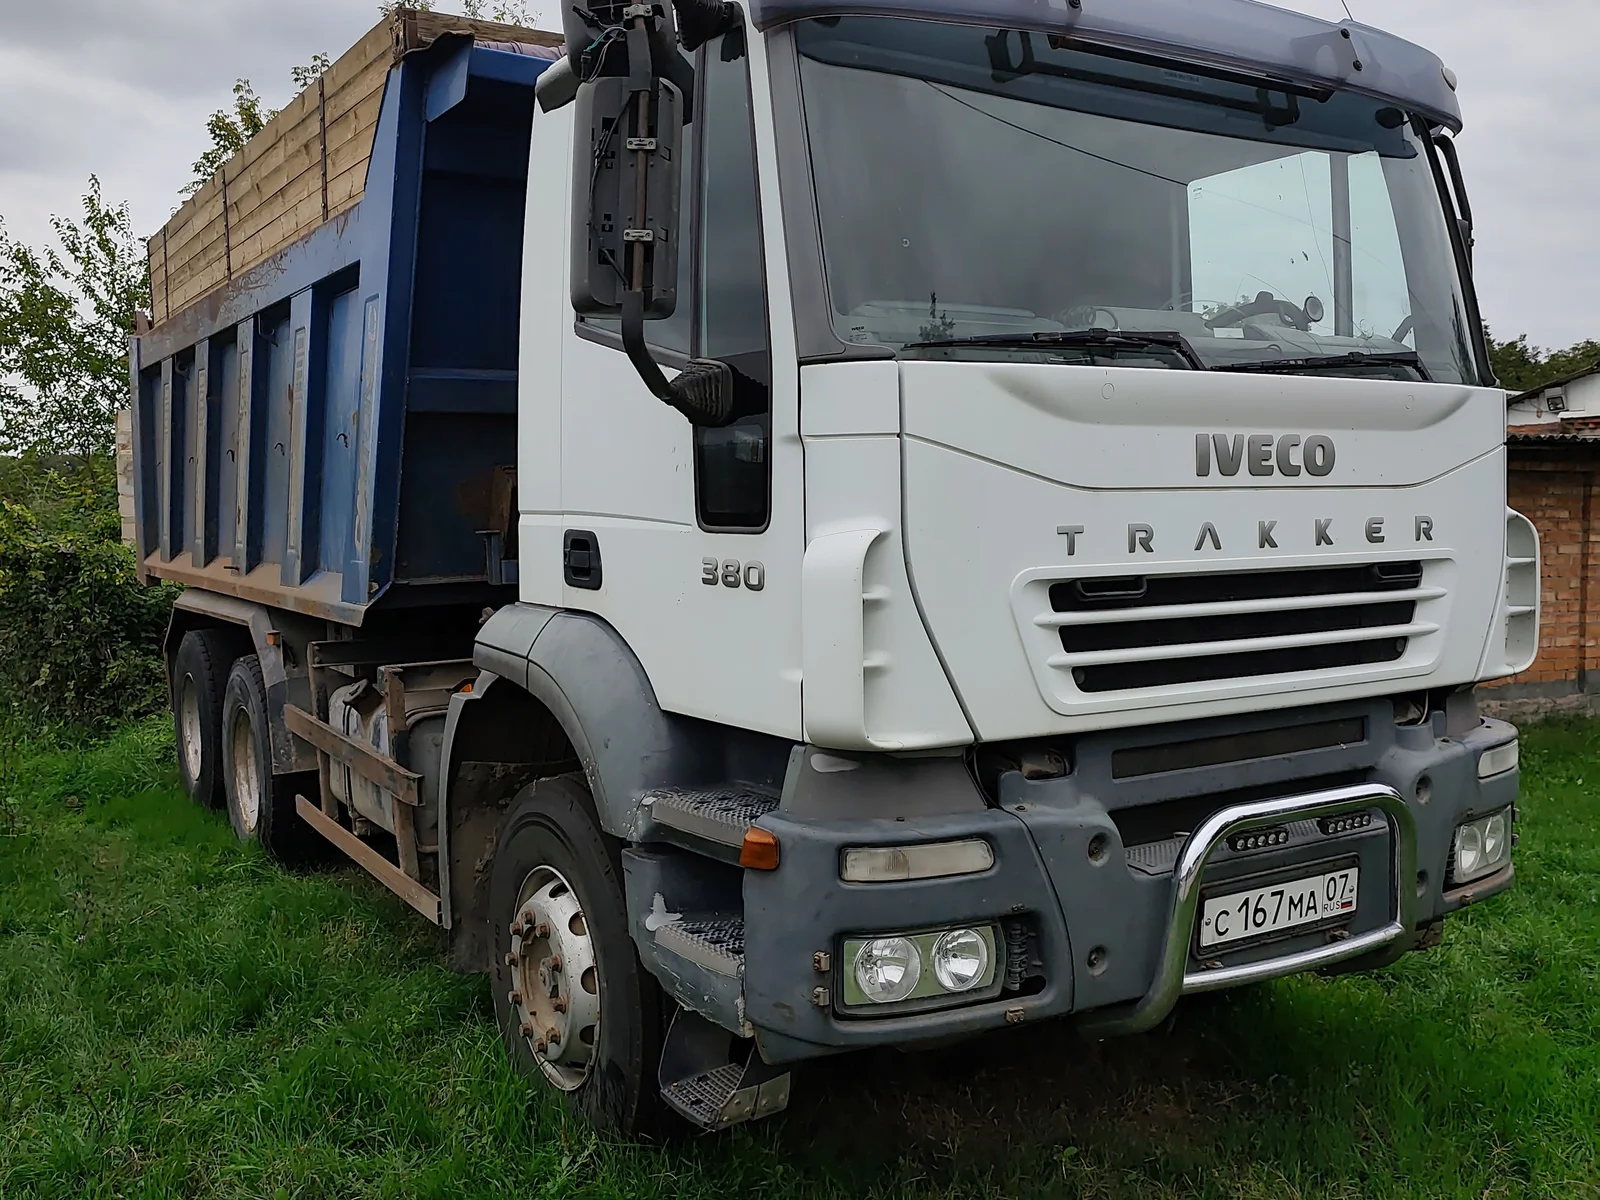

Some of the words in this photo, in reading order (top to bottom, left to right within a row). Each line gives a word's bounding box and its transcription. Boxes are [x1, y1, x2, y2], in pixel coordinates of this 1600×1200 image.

[1195, 433, 1336, 477] IVECO
[1056, 515, 1434, 556] TRAKKER
[701, 556, 766, 592] 380
[1326, 873, 1349, 902] 07
[1323, 900, 1341, 914] RUS
